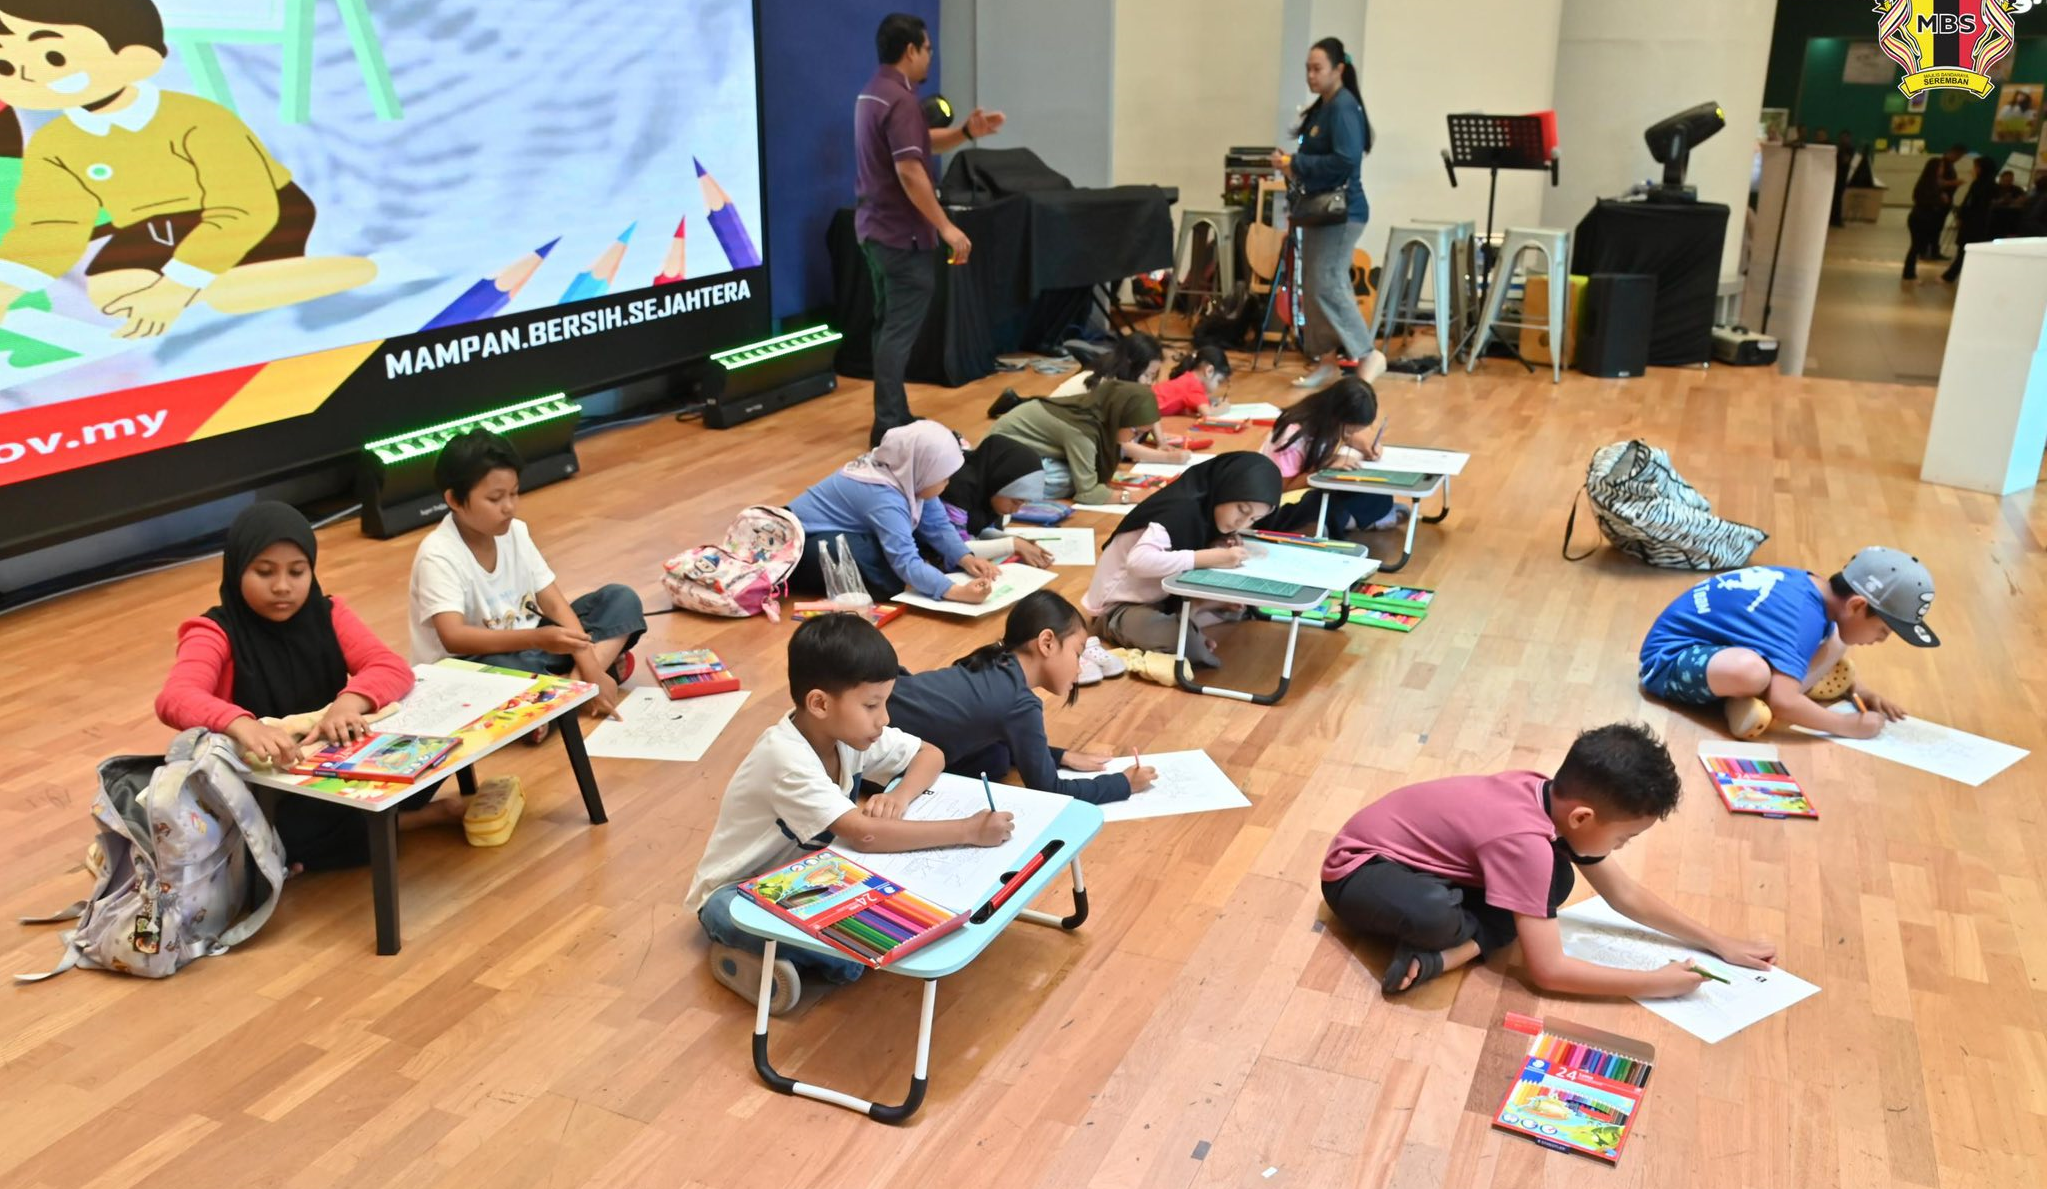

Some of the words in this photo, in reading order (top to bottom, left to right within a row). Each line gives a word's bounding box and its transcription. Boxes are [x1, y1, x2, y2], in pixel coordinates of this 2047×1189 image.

[385, 279, 751, 380] MAMPAN.BERSIH.SEJAHTERA
[855, 892, 878, 907] 24
[1555, 1066, 1578, 1081] 24
